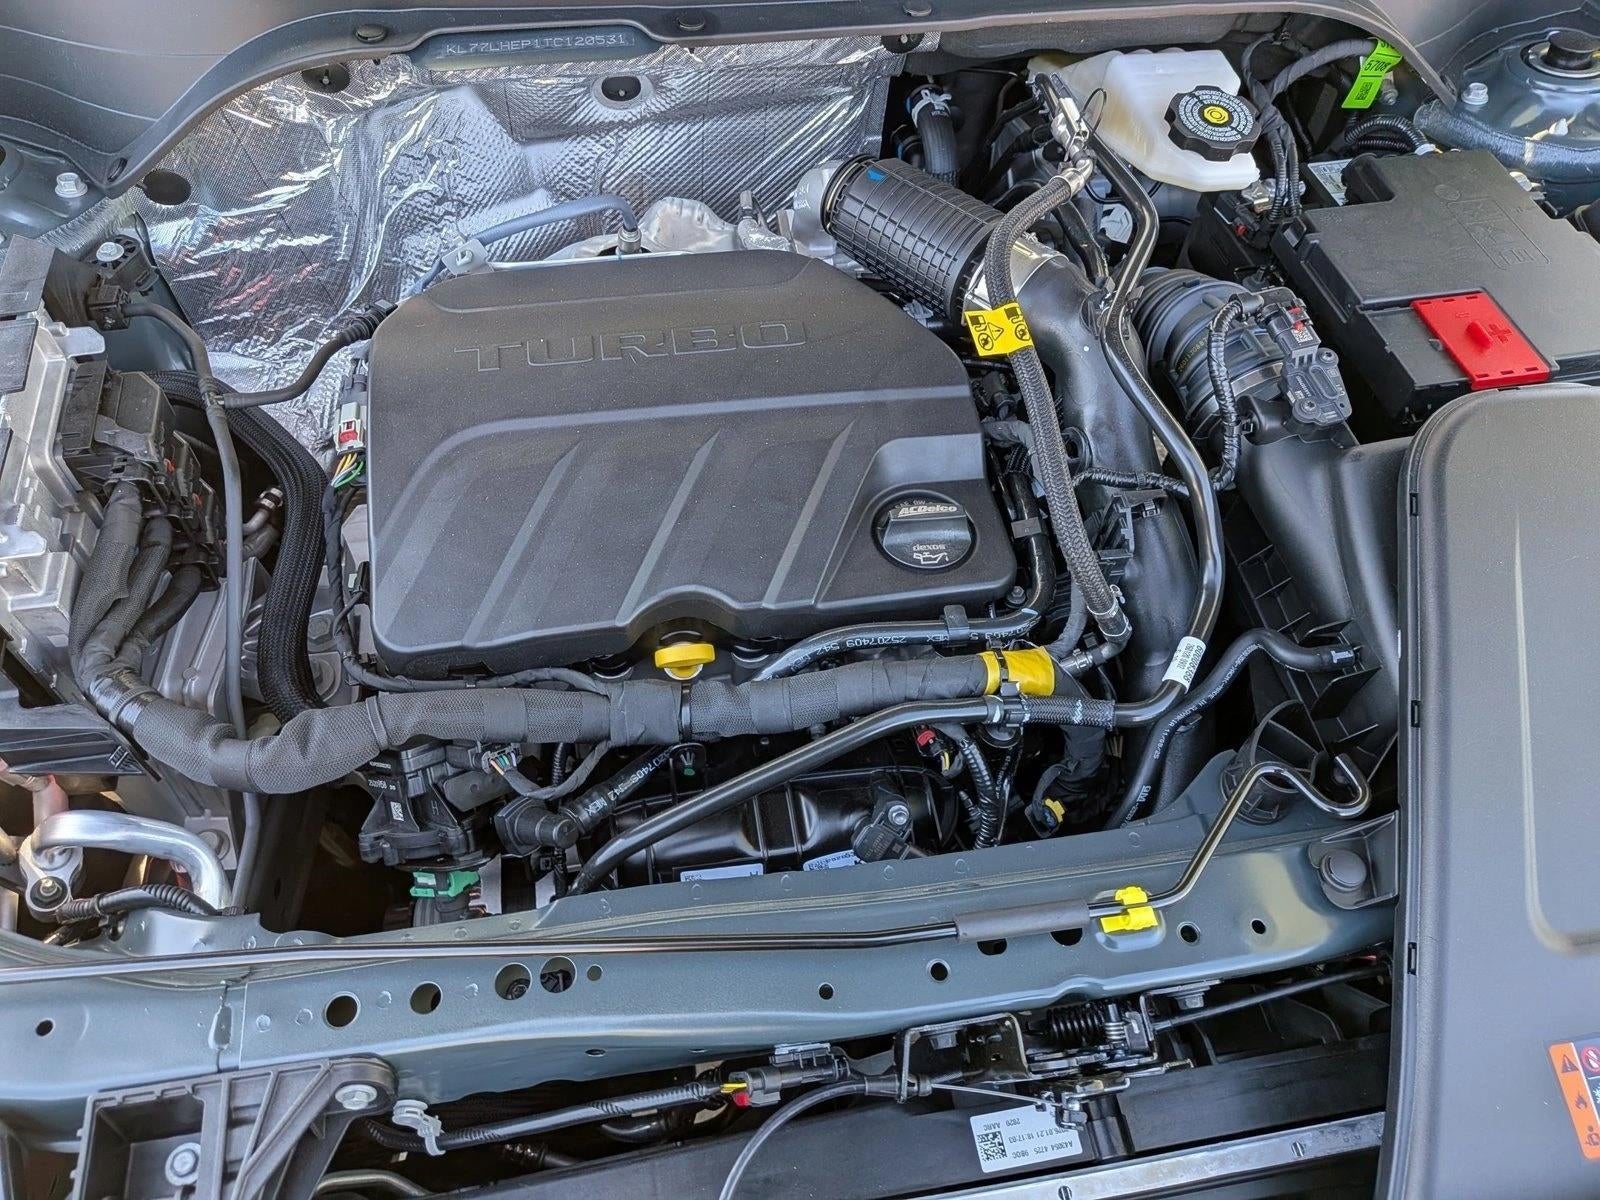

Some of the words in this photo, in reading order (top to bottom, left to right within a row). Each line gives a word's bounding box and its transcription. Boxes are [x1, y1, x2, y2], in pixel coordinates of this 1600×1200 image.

[445, 33, 626, 54] KL77LHEP1TC120531
[453, 322, 807, 372] TURBO
[897, 504, 958, 518] ACDelco
[912, 543, 946, 551] dexos
[845, 635, 907, 648] 25207409
